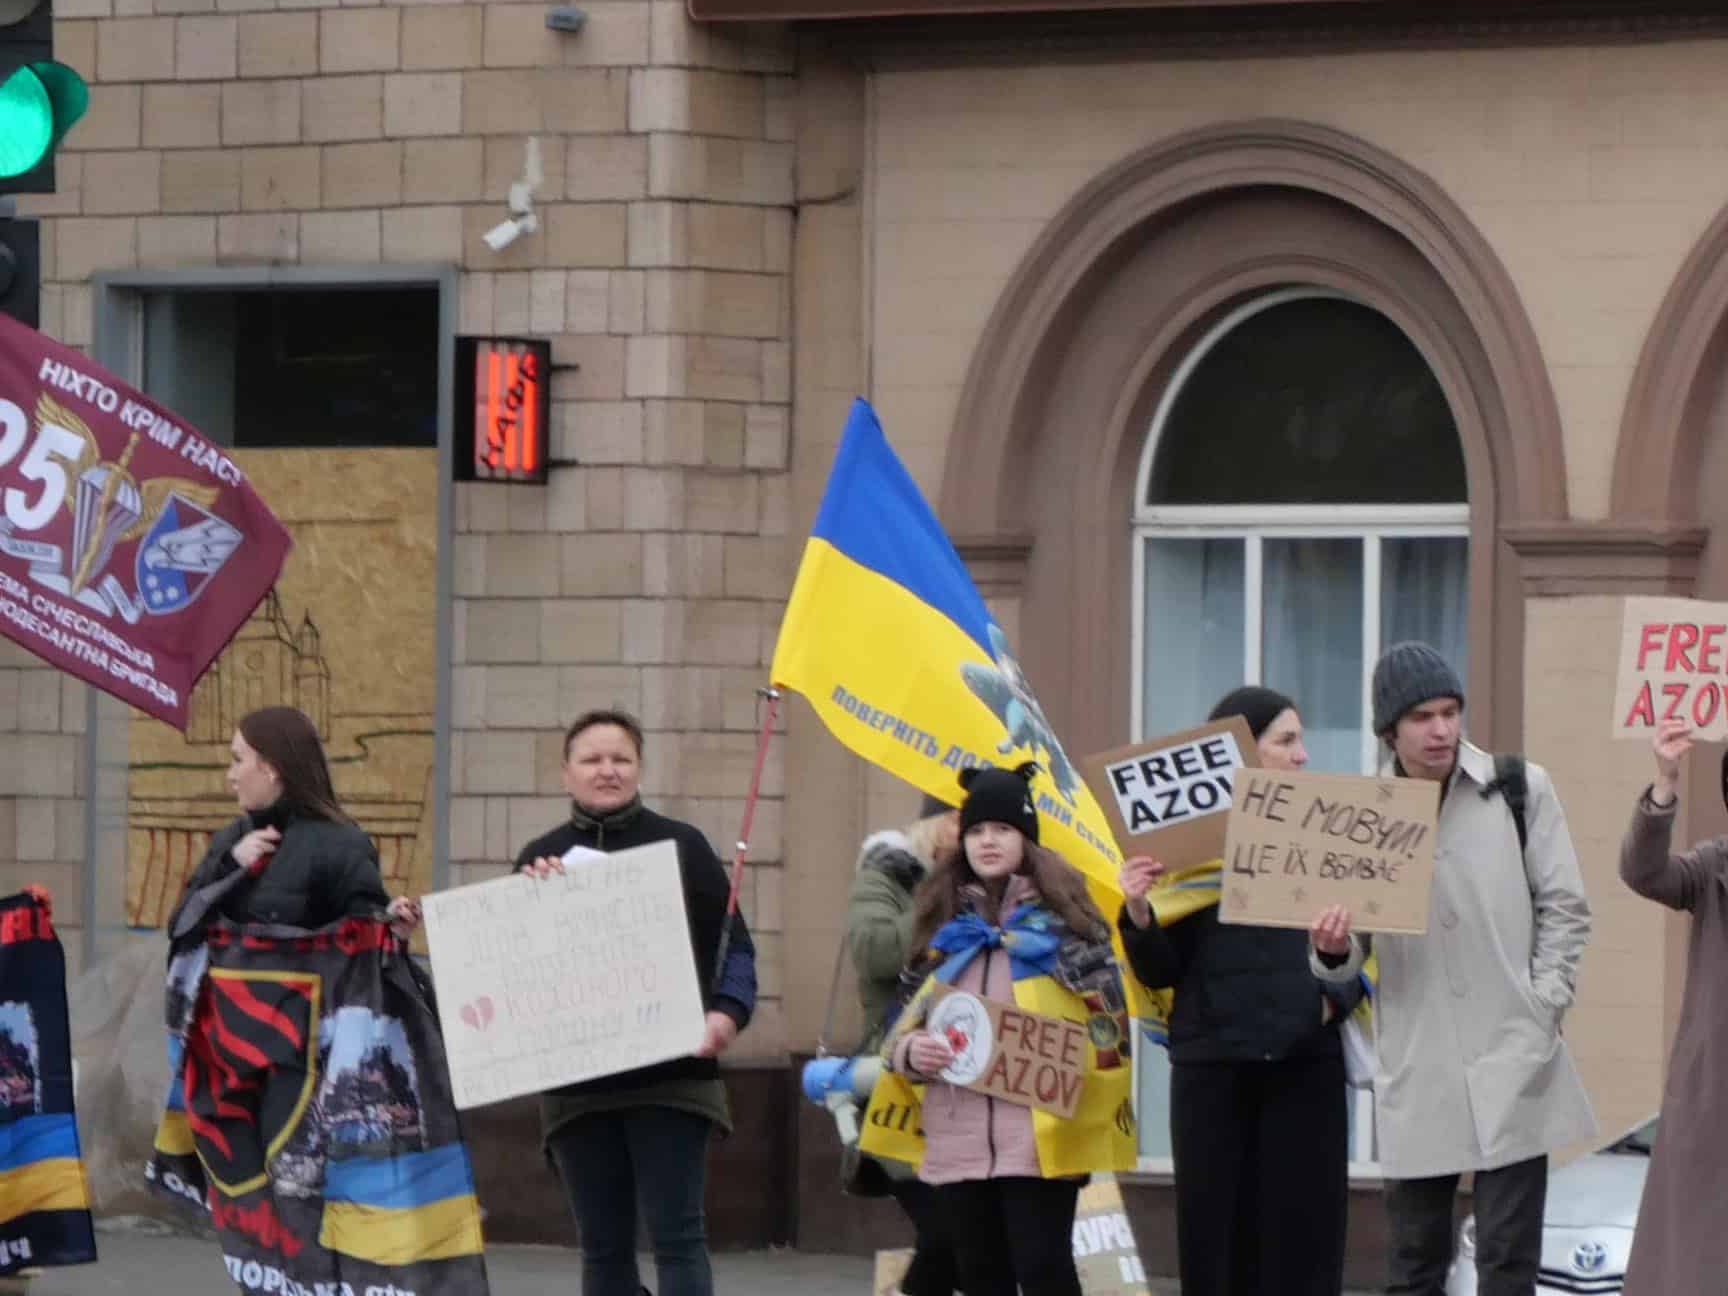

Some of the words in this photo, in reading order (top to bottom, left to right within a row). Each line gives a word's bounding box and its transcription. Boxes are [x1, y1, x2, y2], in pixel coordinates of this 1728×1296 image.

[39, 357, 118, 413] НІХТО
[119, 399, 180, 450] КРІМ
[831, 683, 941, 760] ПОВЕРНІТЬ
[1110, 738, 1232, 796] FREE
[1242, 778, 1295, 823] НЕ
[1301, 796, 1428, 860] МОВЧИ!
[1232, 843, 1278, 878] ЦЕ
[999, 1009, 1084, 1067] FREE
[985, 1057, 1083, 1106] AZOV
